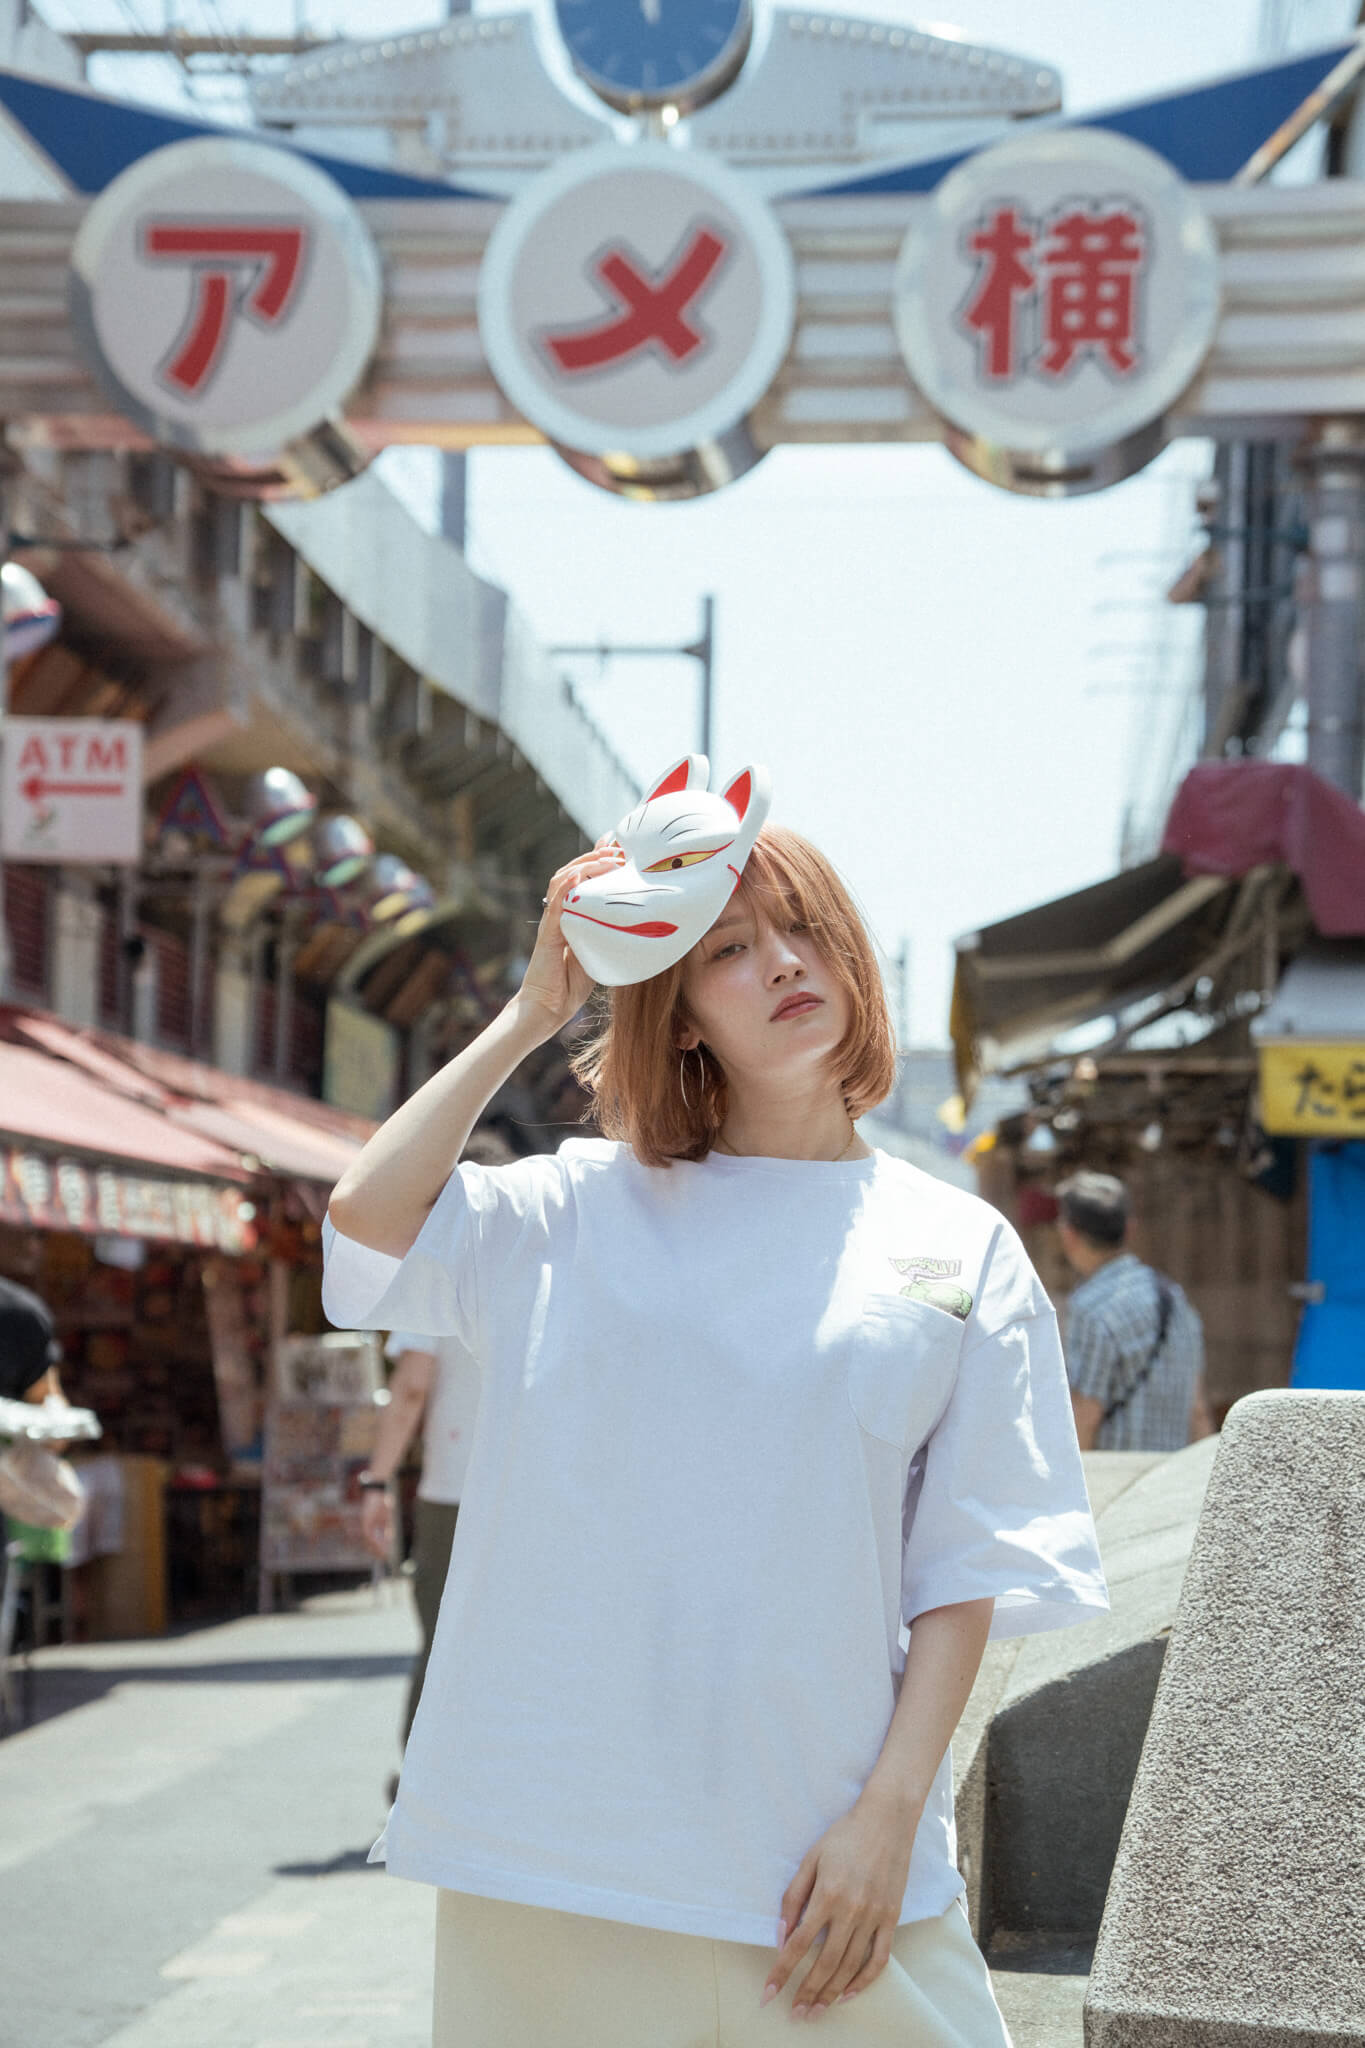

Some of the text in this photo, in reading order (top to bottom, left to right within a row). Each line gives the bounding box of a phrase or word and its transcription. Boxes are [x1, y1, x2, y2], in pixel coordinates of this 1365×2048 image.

[146, 207, 1143, 390] アメ横
[19, 735, 126, 772] ATM
